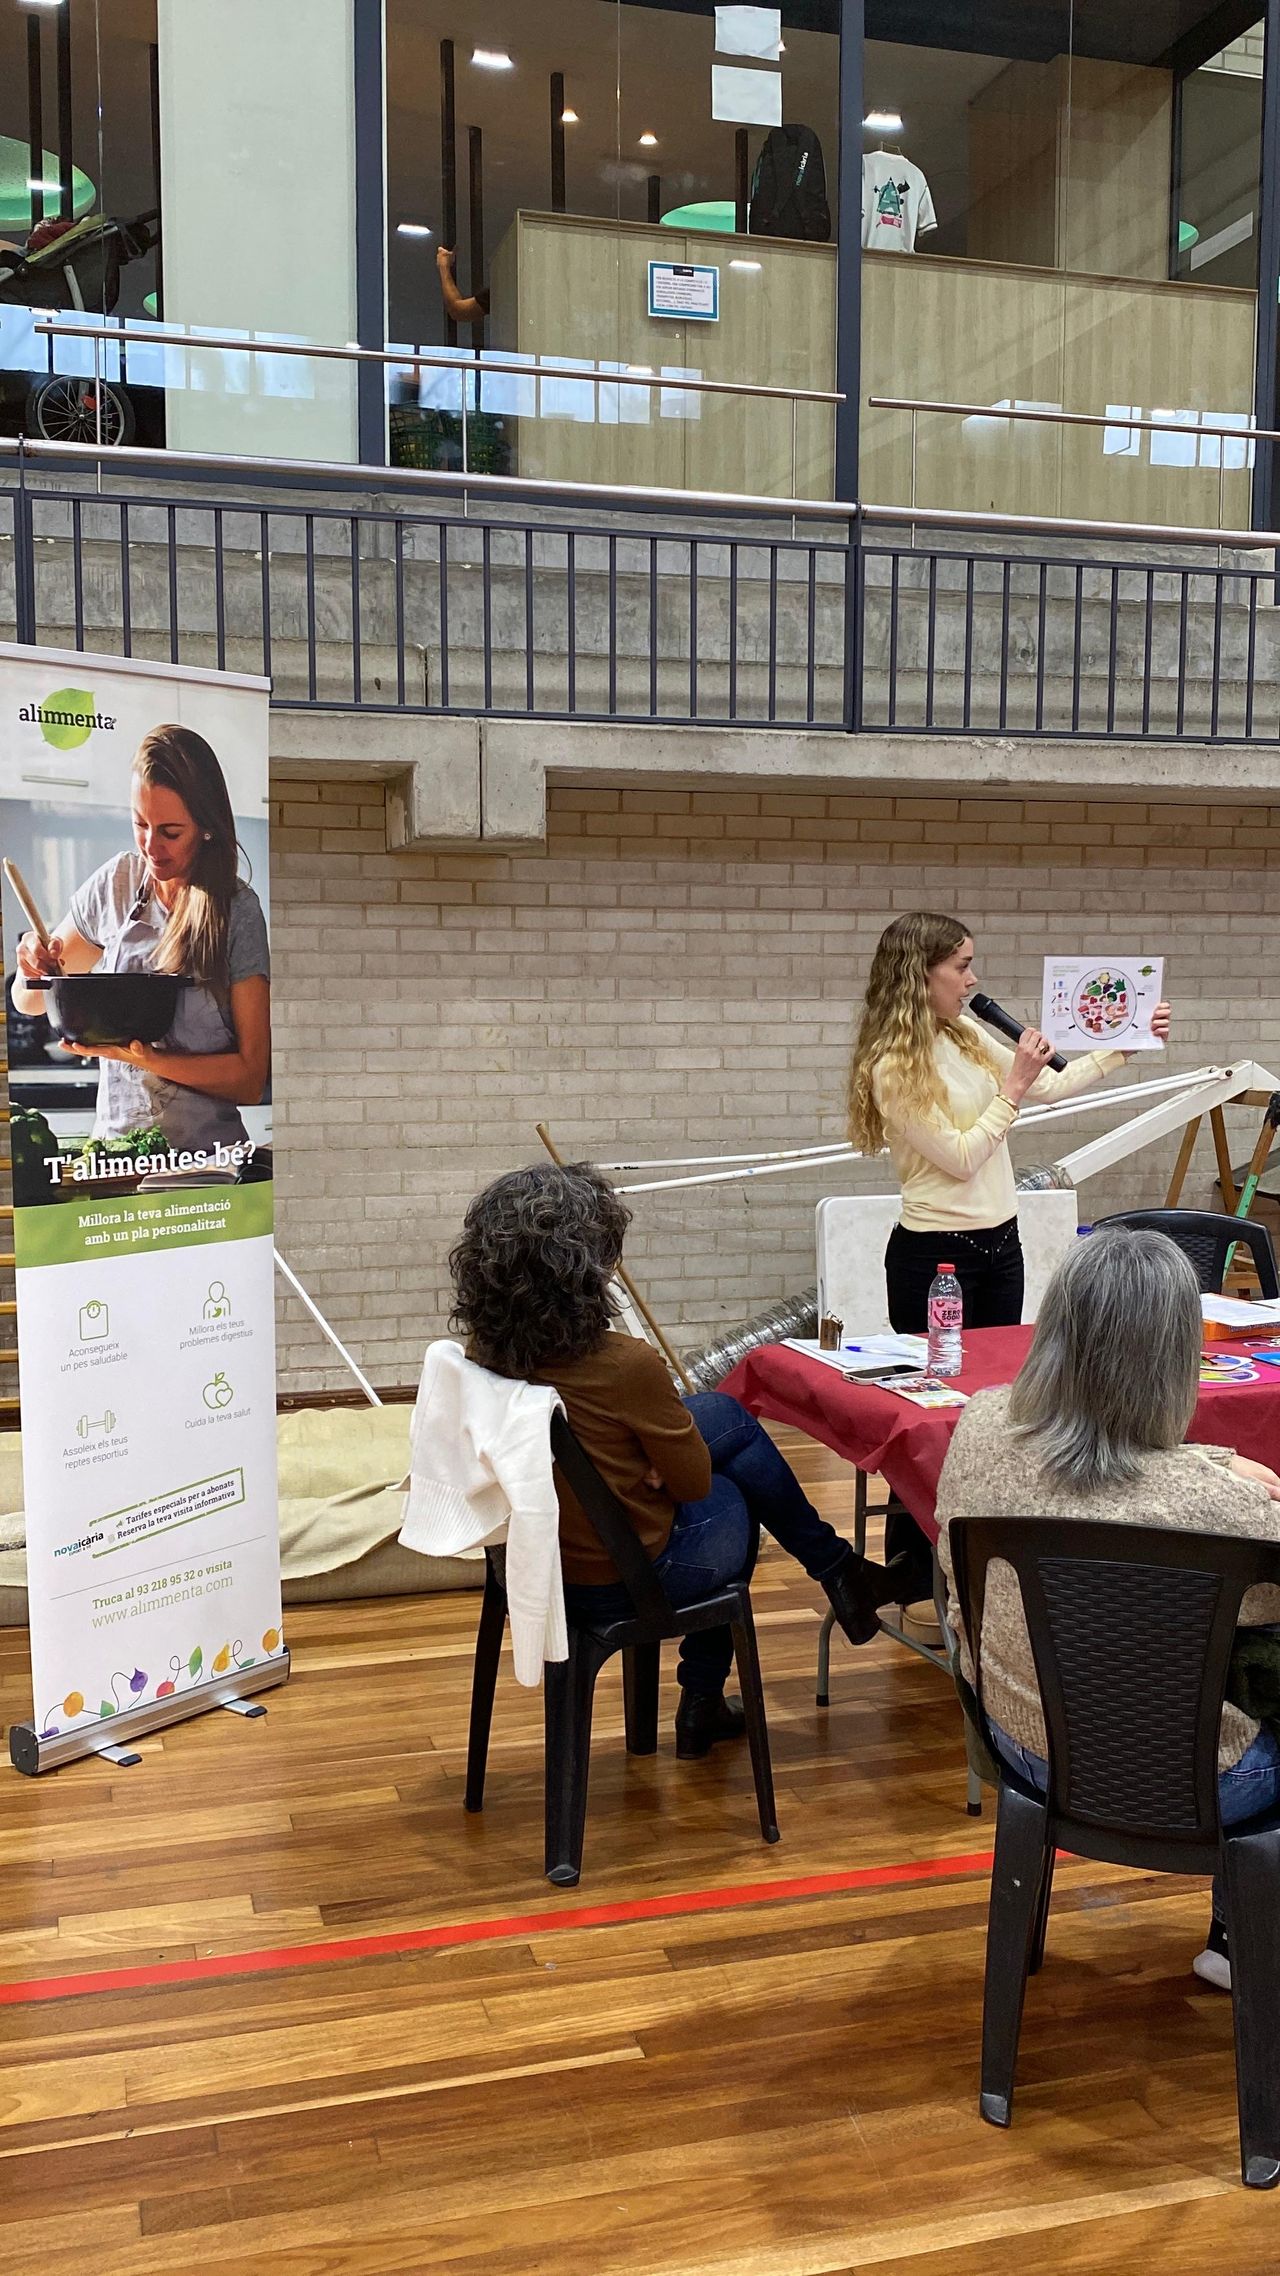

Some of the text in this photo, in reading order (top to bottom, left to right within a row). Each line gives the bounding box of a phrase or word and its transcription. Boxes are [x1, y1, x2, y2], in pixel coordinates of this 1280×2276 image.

[19, 704, 116, 730] alimmenta
[44, 1141, 257, 1184] T'alimentes bé?
[78, 1199, 231, 1228] Millora la teva alimentació
[85, 1217, 227, 1246] amb un pla personalitzat
[179, 1329, 254, 1350] problemes digestius
[189, 1320, 245, 1335] Millora els teus
[60, 1352, 128, 1372] un pes saludable
[69, 1342, 120, 1358] Aconsegueix
[184, 1407, 251, 1429] Cuida la teva salut
[62, 1436, 129, 1457] Assoleix els teus
[65, 1448, 129, 1469] reptes esportius
[117, 1490, 236, 1540] Reserva la teva visita informativa
[126, 1510, 152, 1525] Tarifes
[154, 1497, 187, 1514] especials
[188, 1492, 200, 1503] per
[206, 1479, 235, 1495] abonats
[53, 1531, 105, 1557] novaicària
[92, 1560, 233, 1610] Truca al 93 218 95 32 o visita
[91, 1576, 234, 1629] www.alimmenta.com
